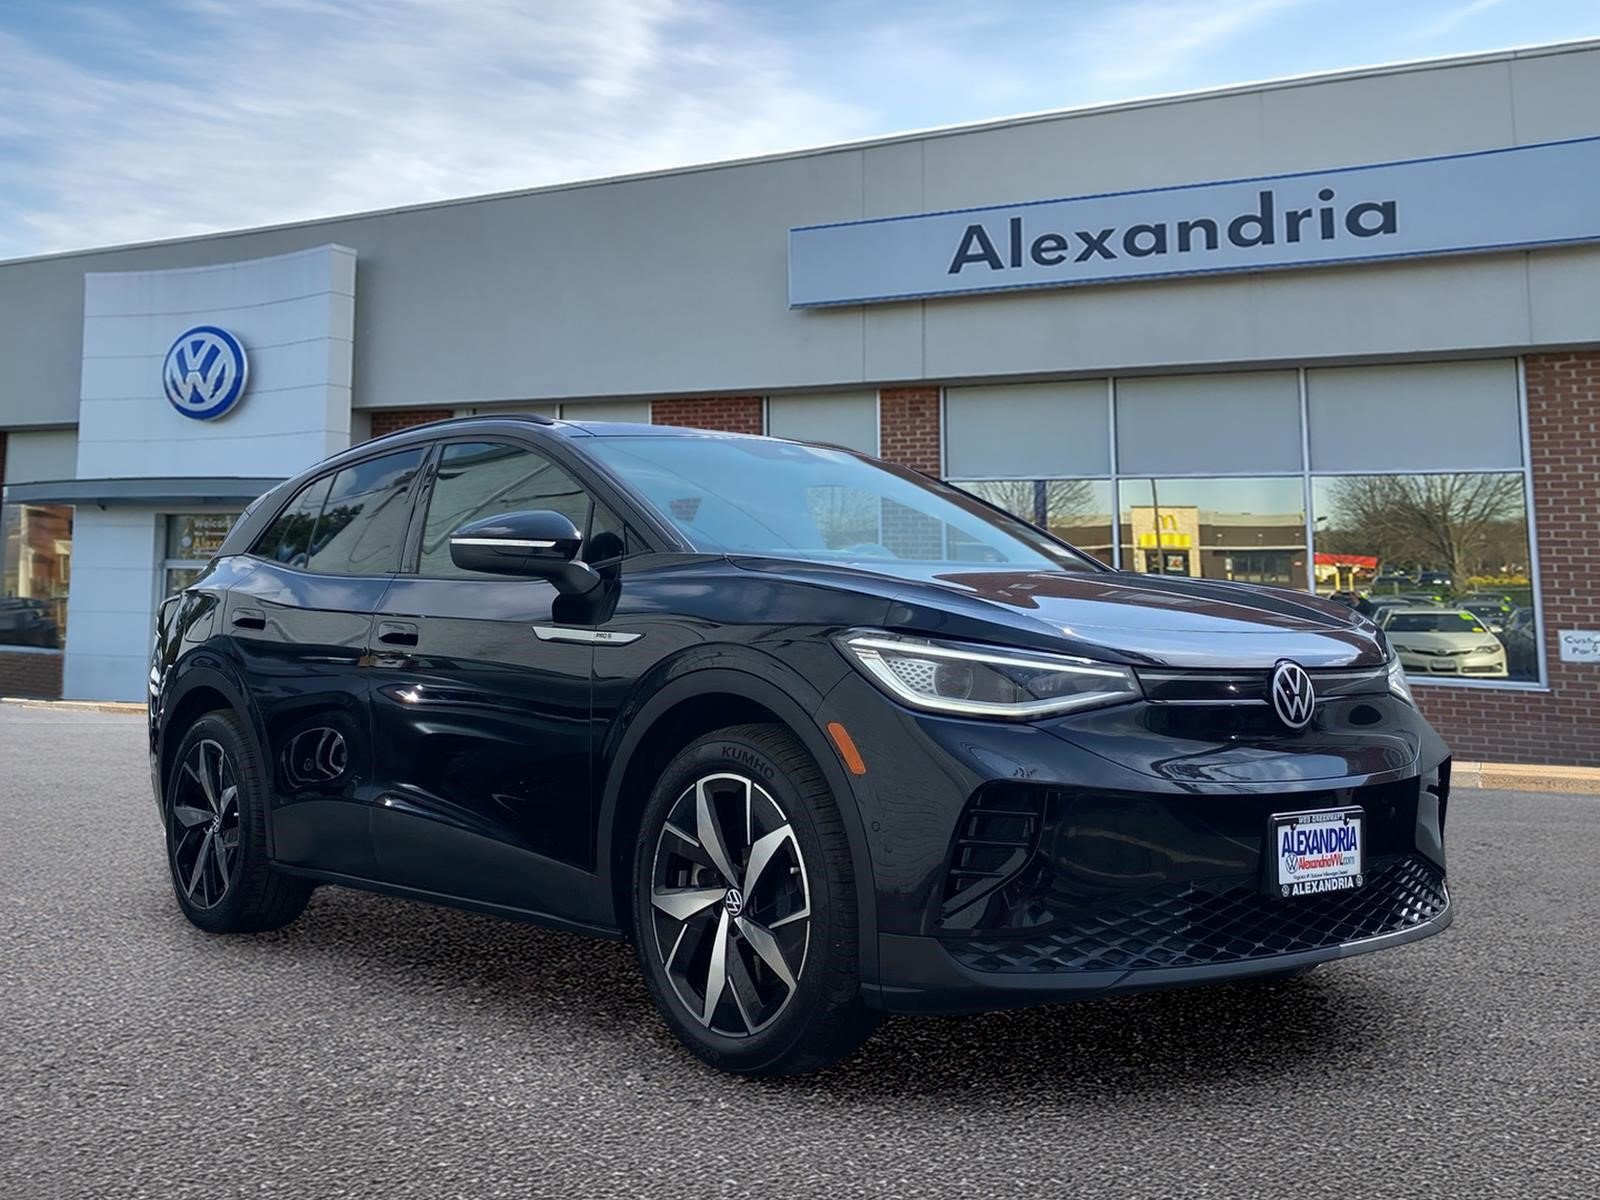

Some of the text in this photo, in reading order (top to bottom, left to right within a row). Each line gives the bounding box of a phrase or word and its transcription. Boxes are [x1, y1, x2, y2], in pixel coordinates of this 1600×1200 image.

[948, 188, 1397, 274] Alexandria
[721, 746, 775, 779] KUMHO
[1282, 826, 1357, 857] ALEXANDRIA
[1292, 877, 1354, 896] ALEXANDRIA
